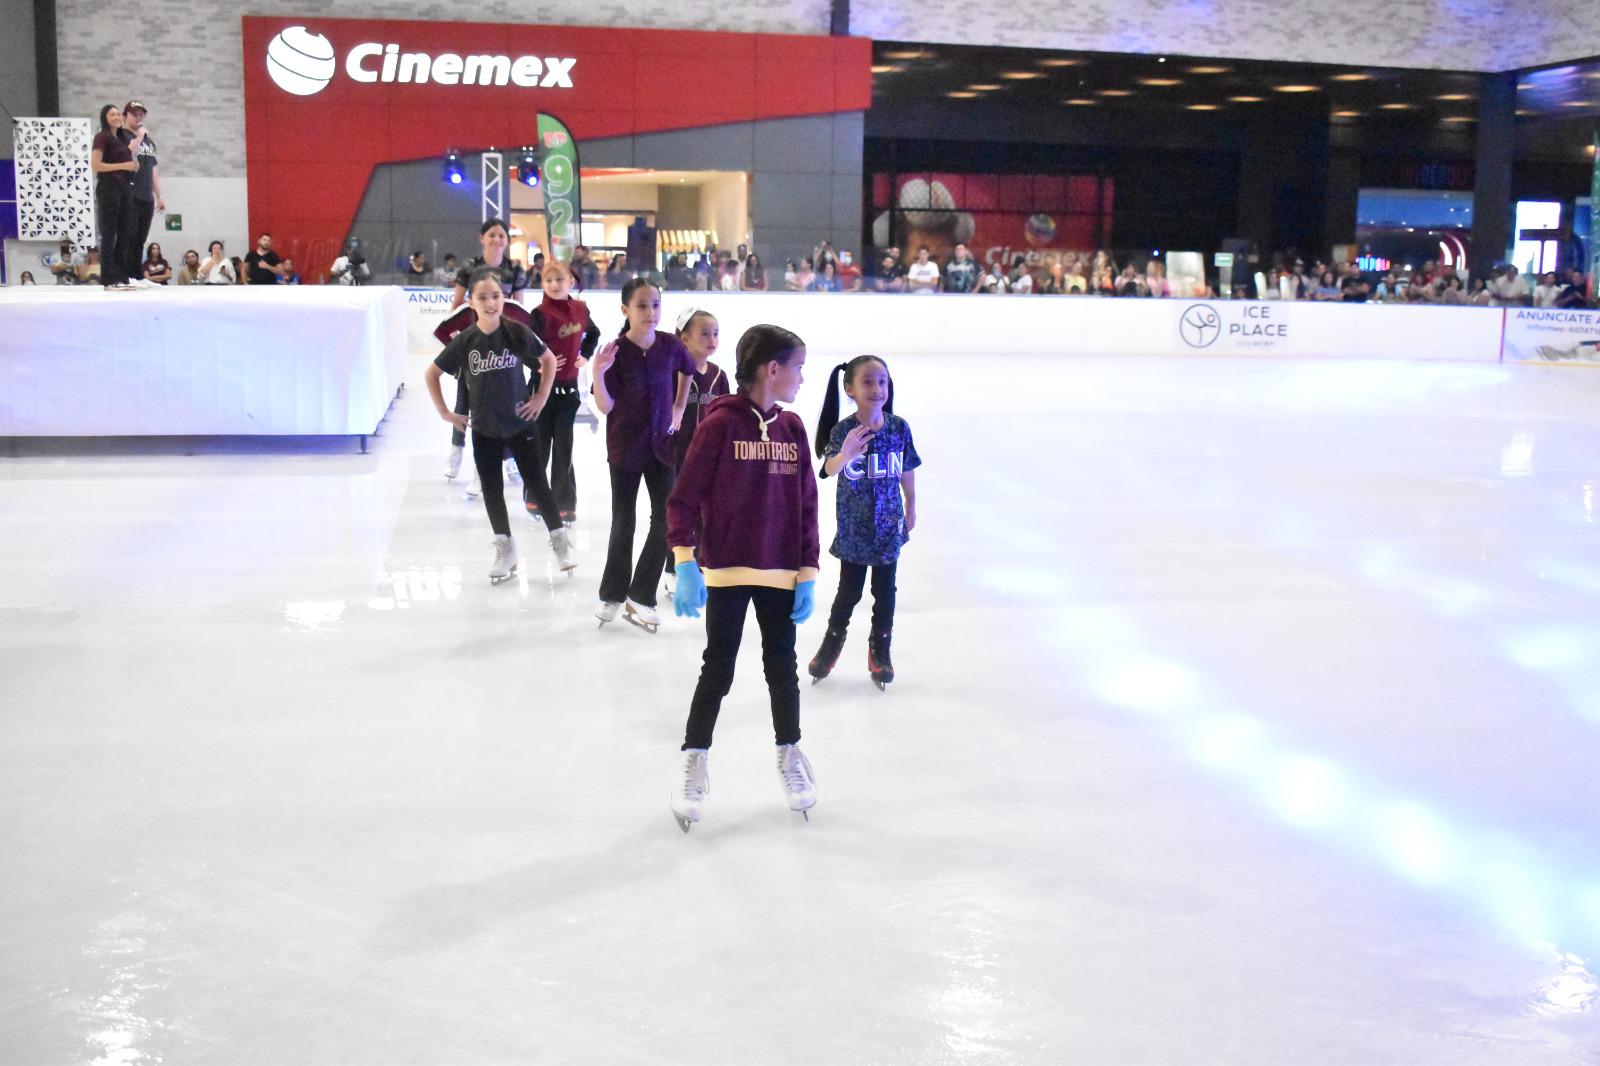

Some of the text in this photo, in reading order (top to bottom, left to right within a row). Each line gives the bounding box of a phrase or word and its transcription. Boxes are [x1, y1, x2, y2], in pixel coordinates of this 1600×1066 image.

[346, 42, 577, 88] Cinemex
[1244, 306, 1270, 318] ICE
[1517, 311, 1592, 324] ANUNCIATE
[1230, 324, 1287, 336] PLACE
[733, 441, 798, 461] TOMATEROS
[844, 452, 904, 480] CLN
